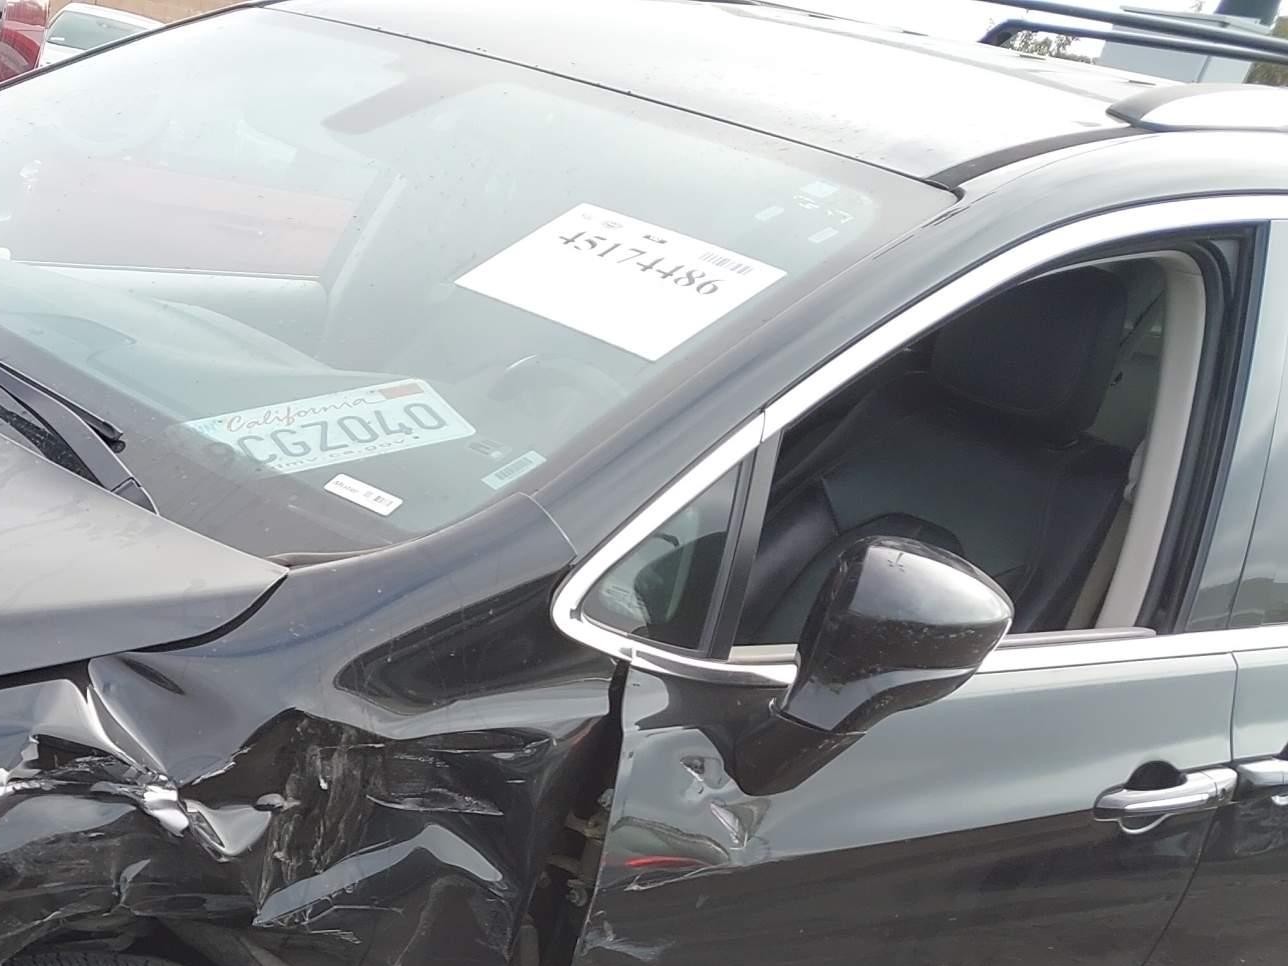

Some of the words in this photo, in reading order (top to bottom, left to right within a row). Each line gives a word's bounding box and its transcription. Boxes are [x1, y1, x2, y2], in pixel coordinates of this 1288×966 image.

[558, 231, 724, 295] 45174486
[208, 402, 448, 465] CGZ040
[226, 396, 386, 433] California
